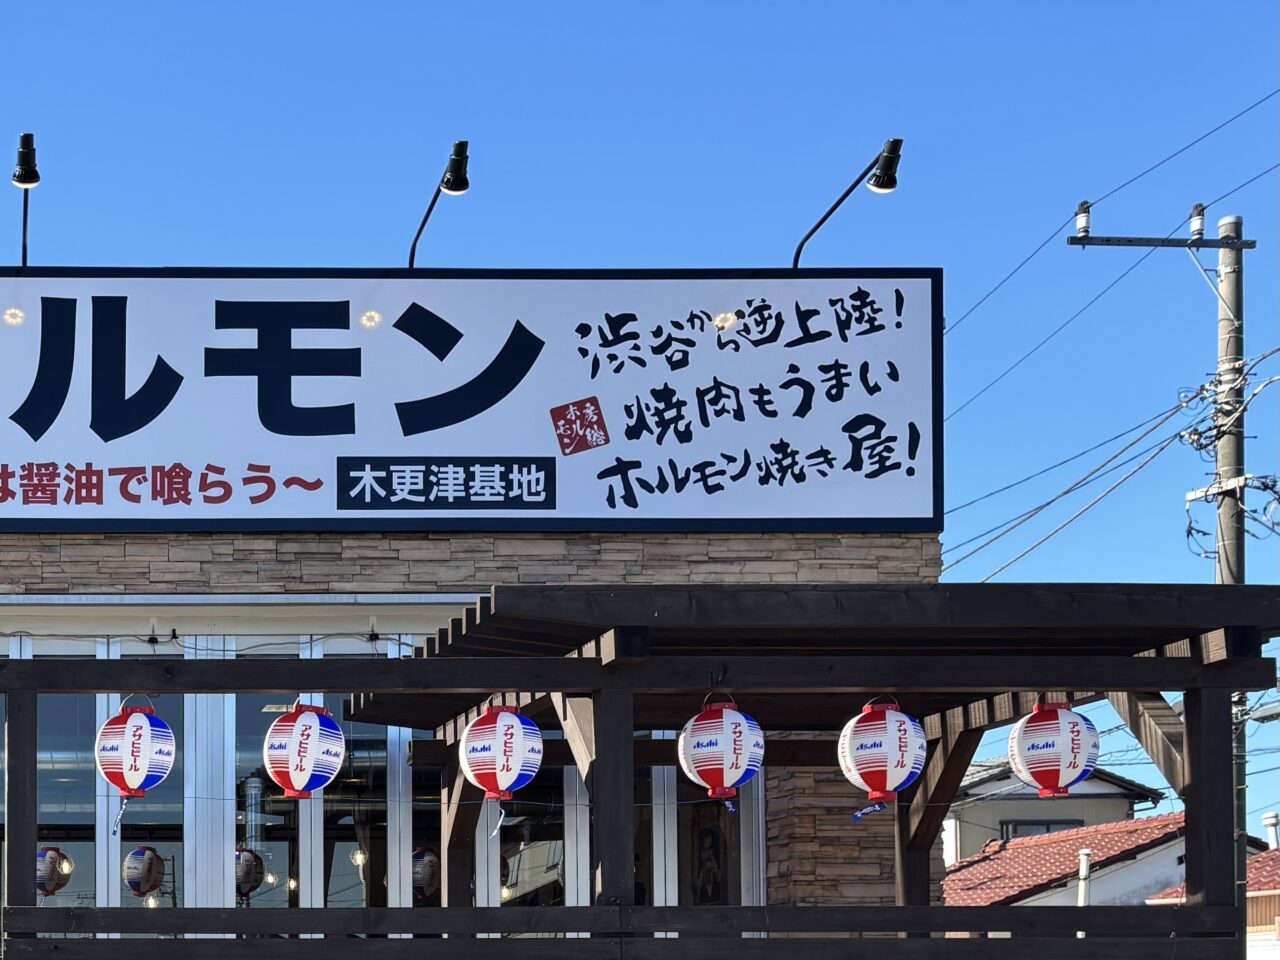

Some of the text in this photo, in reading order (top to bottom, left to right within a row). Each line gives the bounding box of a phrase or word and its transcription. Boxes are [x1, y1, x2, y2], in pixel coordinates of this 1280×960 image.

[624, 358, 900, 446] 焼肉もうまい
[348, 463, 547, 503] 木更津基地
[596, 413, 921, 510] ホルモン焼き屋！
[128, 725, 143, 772] アサヒビール
[294, 724, 312, 772] アサヒビール
[469, 744, 491, 754] Asahi
[500, 724, 515, 772] アサヒビール
[693, 739, 718, 749] Asahi
[729, 722, 743, 770] アサヒビール
[856, 740, 882, 751] Asahi
[894, 719, 908, 769] アサヒビール
[1027, 741, 1055, 752] Asahi
[1066, 721, 1081, 769] アサヒビール
